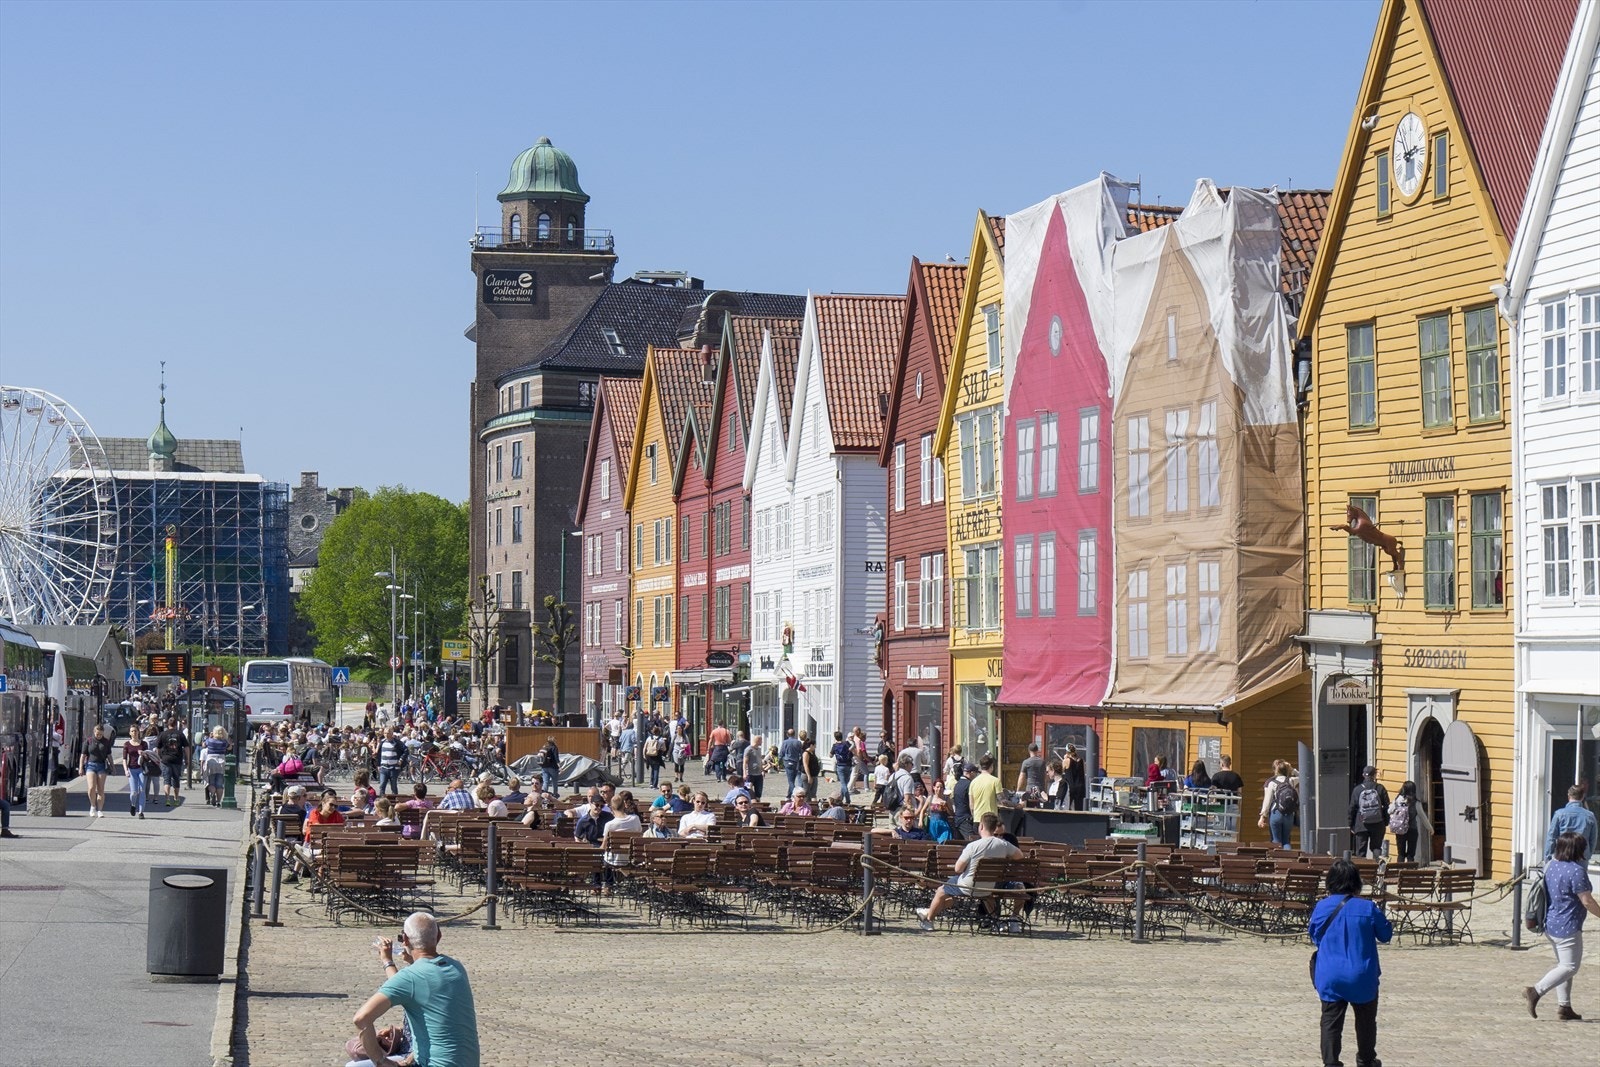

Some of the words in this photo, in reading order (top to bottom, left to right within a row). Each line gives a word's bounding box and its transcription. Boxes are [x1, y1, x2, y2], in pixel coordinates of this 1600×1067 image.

[486, 274, 517, 286] Clarion
[493, 287, 533, 295] Collection
[963, 369, 989, 407] SILD
[1388, 456, 1456, 484] ENHJØRNINGEN
[956, 508, 990, 542] ALFRED
[864, 560, 886, 572] RA
[1404, 648, 1466, 669] SJØBODEN
[209, 677, 218, 687] A
[1330, 688, 1341, 699] To
[1341, 688, 1369, 699] Kokker
